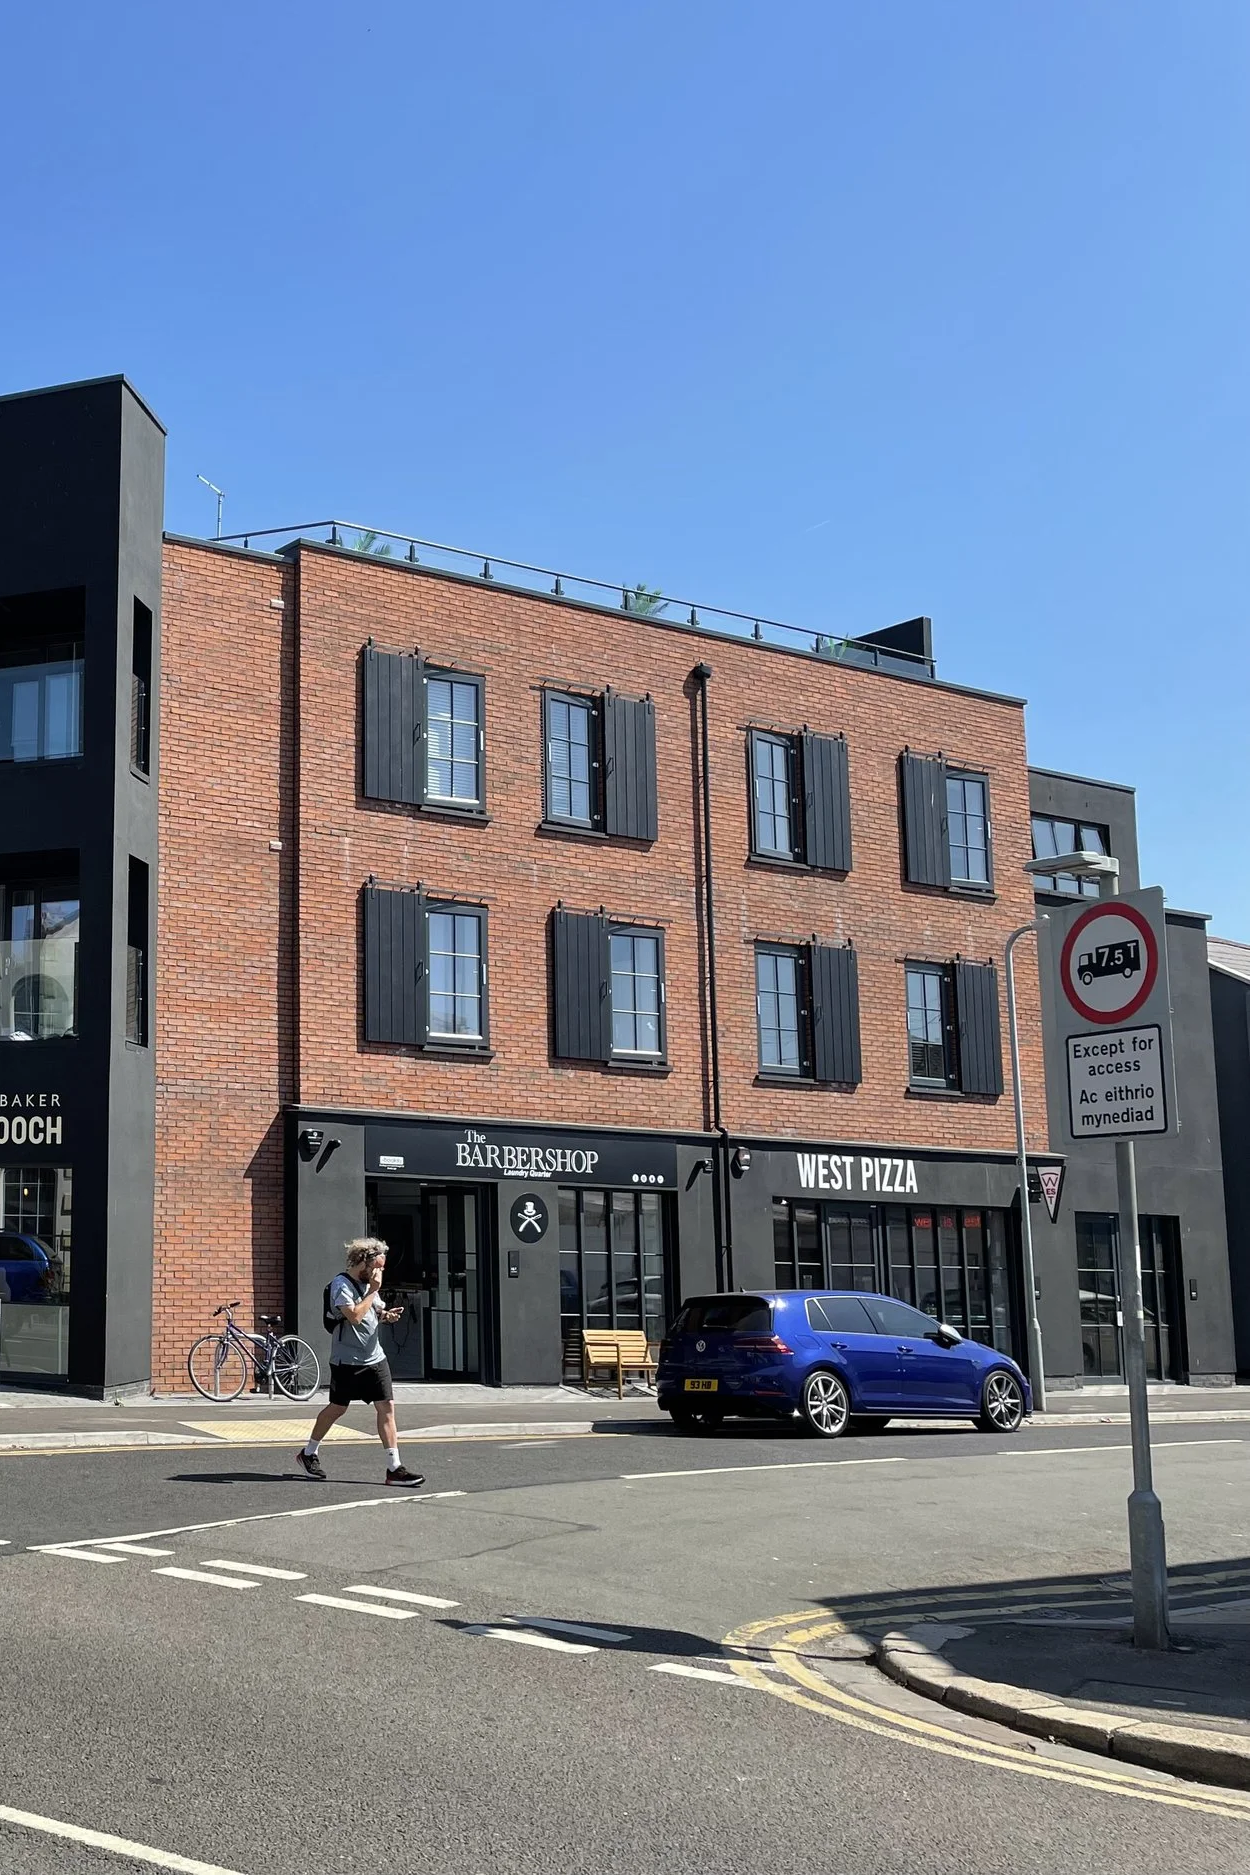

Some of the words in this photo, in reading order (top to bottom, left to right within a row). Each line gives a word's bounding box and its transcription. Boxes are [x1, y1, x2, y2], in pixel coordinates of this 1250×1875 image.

[1098, 947, 1124, 967] 7.5
[1126, 942, 1137, 959] T
[1073, 1039, 1125, 1059] Except
[1131, 1036, 1154, 1051] for
[1088, 1060, 1141, 1077] access
[0, 1094, 61, 1107] BAKER
[1079, 1089, 1098, 1105] Ac
[1105, 1084, 1154, 1102] eithrio
[1081, 1106, 1155, 1128] mynediad
[464, 1128, 486, 1144] The
[455, 1143, 599, 1174] BARBERSHOP
[796, 1153, 854, 1191] WEST
[860, 1156, 919, 1194] PIZZA
